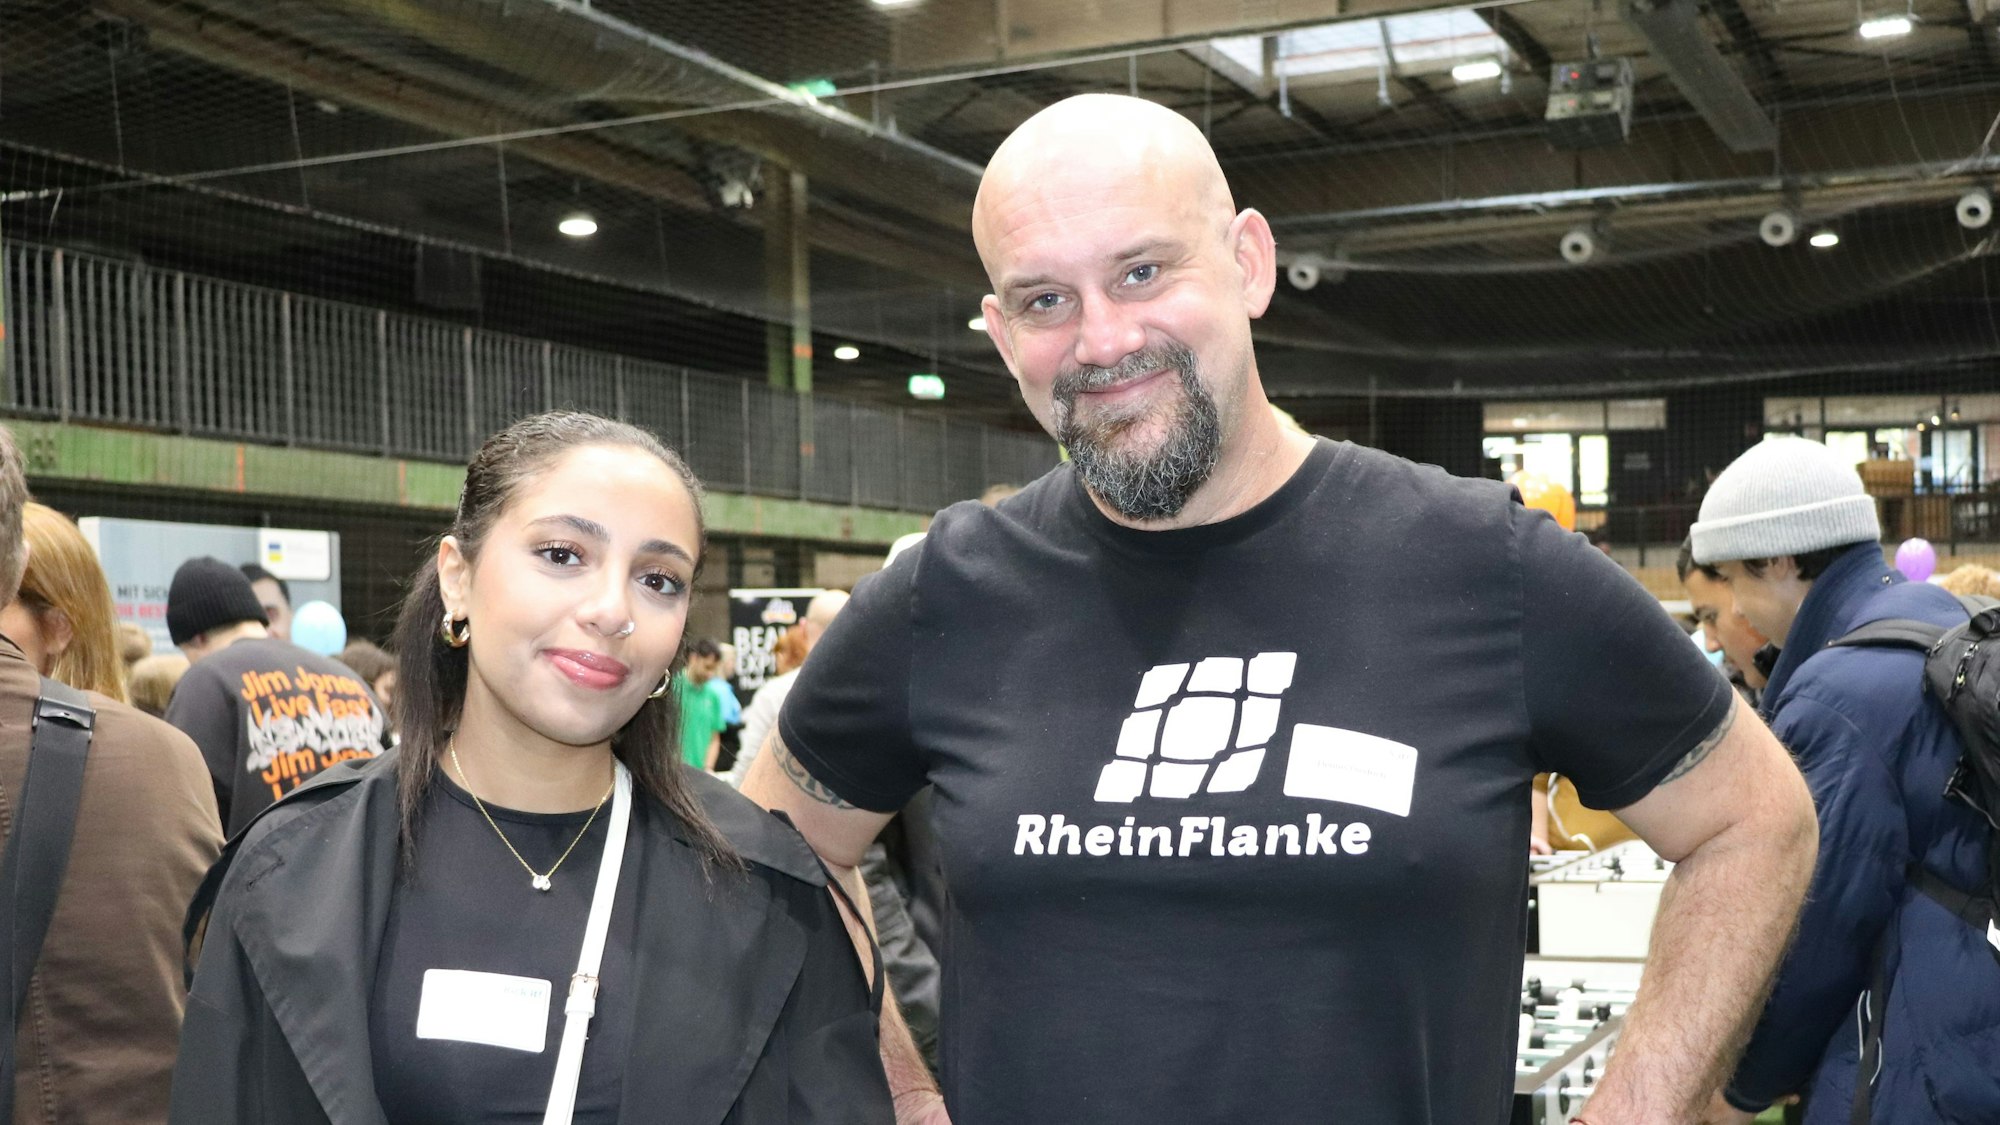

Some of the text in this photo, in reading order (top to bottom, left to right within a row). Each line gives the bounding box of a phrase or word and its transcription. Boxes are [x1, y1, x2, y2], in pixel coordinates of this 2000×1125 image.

[117, 584, 138, 599] MIT
[241, 670, 292, 701] Jim
[251, 690, 312, 728] Live
[262, 748, 316, 784] Jim
[1013, 813, 1372, 857] RheinFlanke
